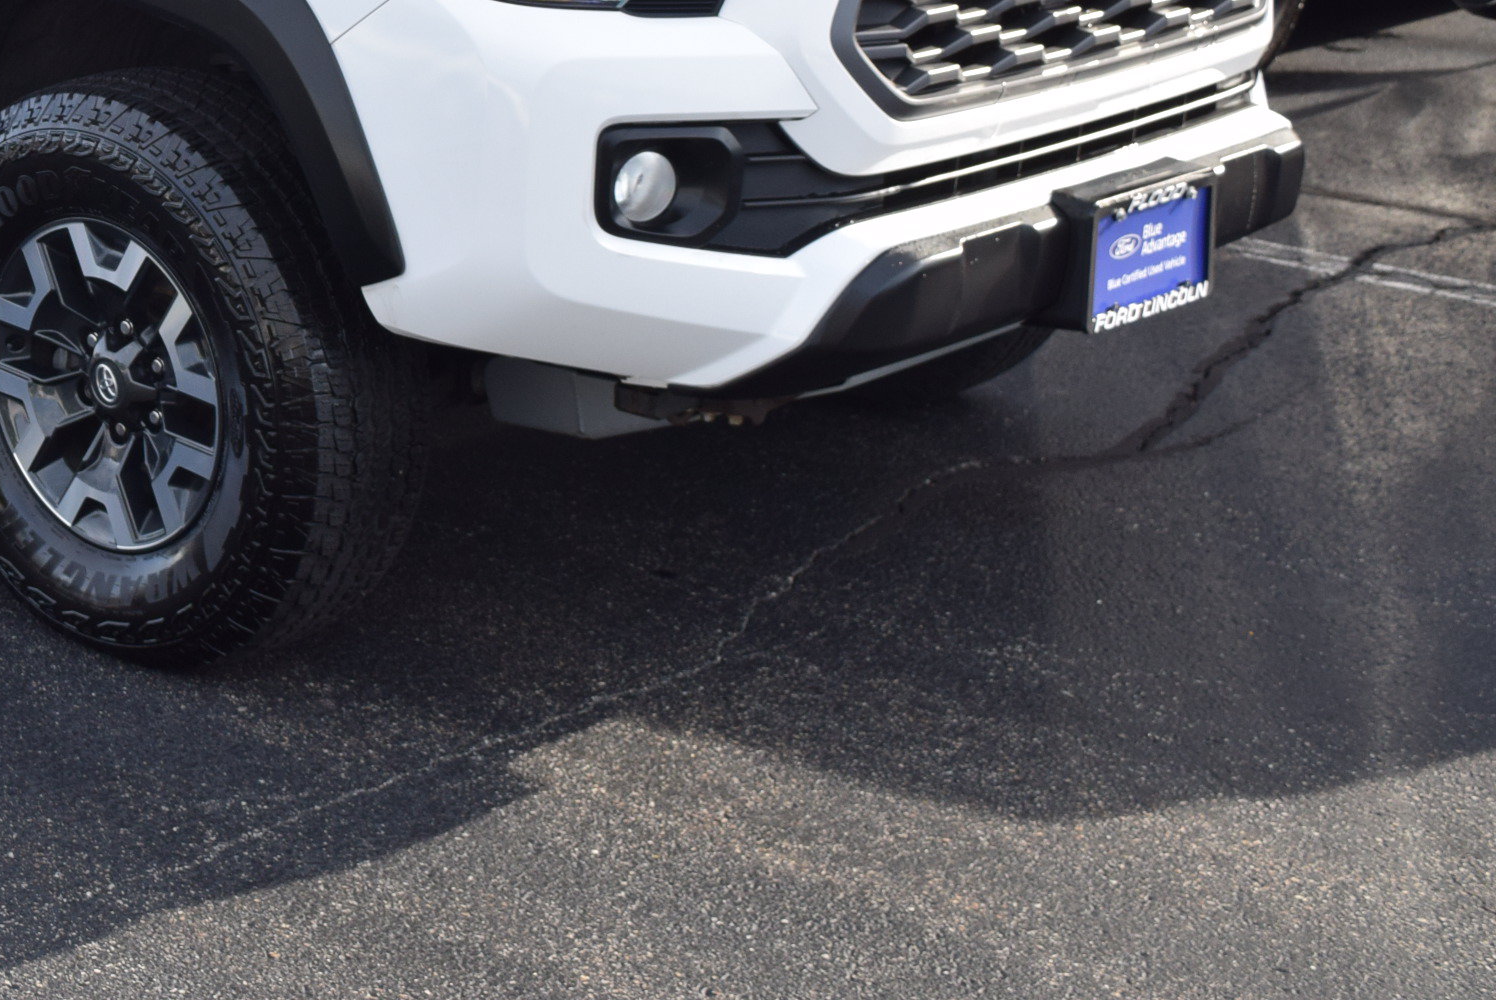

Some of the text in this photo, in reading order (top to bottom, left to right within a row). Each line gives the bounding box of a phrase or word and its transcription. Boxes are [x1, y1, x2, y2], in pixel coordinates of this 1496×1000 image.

[1127, 181, 1188, 214] FLOOD
[1140, 230, 1188, 256] Advantage
[1142, 222, 1163, 240] Blue
[1107, 277, 1122, 291] Blue
[1147, 261, 1164, 277] Used
[1164, 255, 1187, 271] Vehicle
[1093, 280, 1209, 334] FORD LINCOLN
